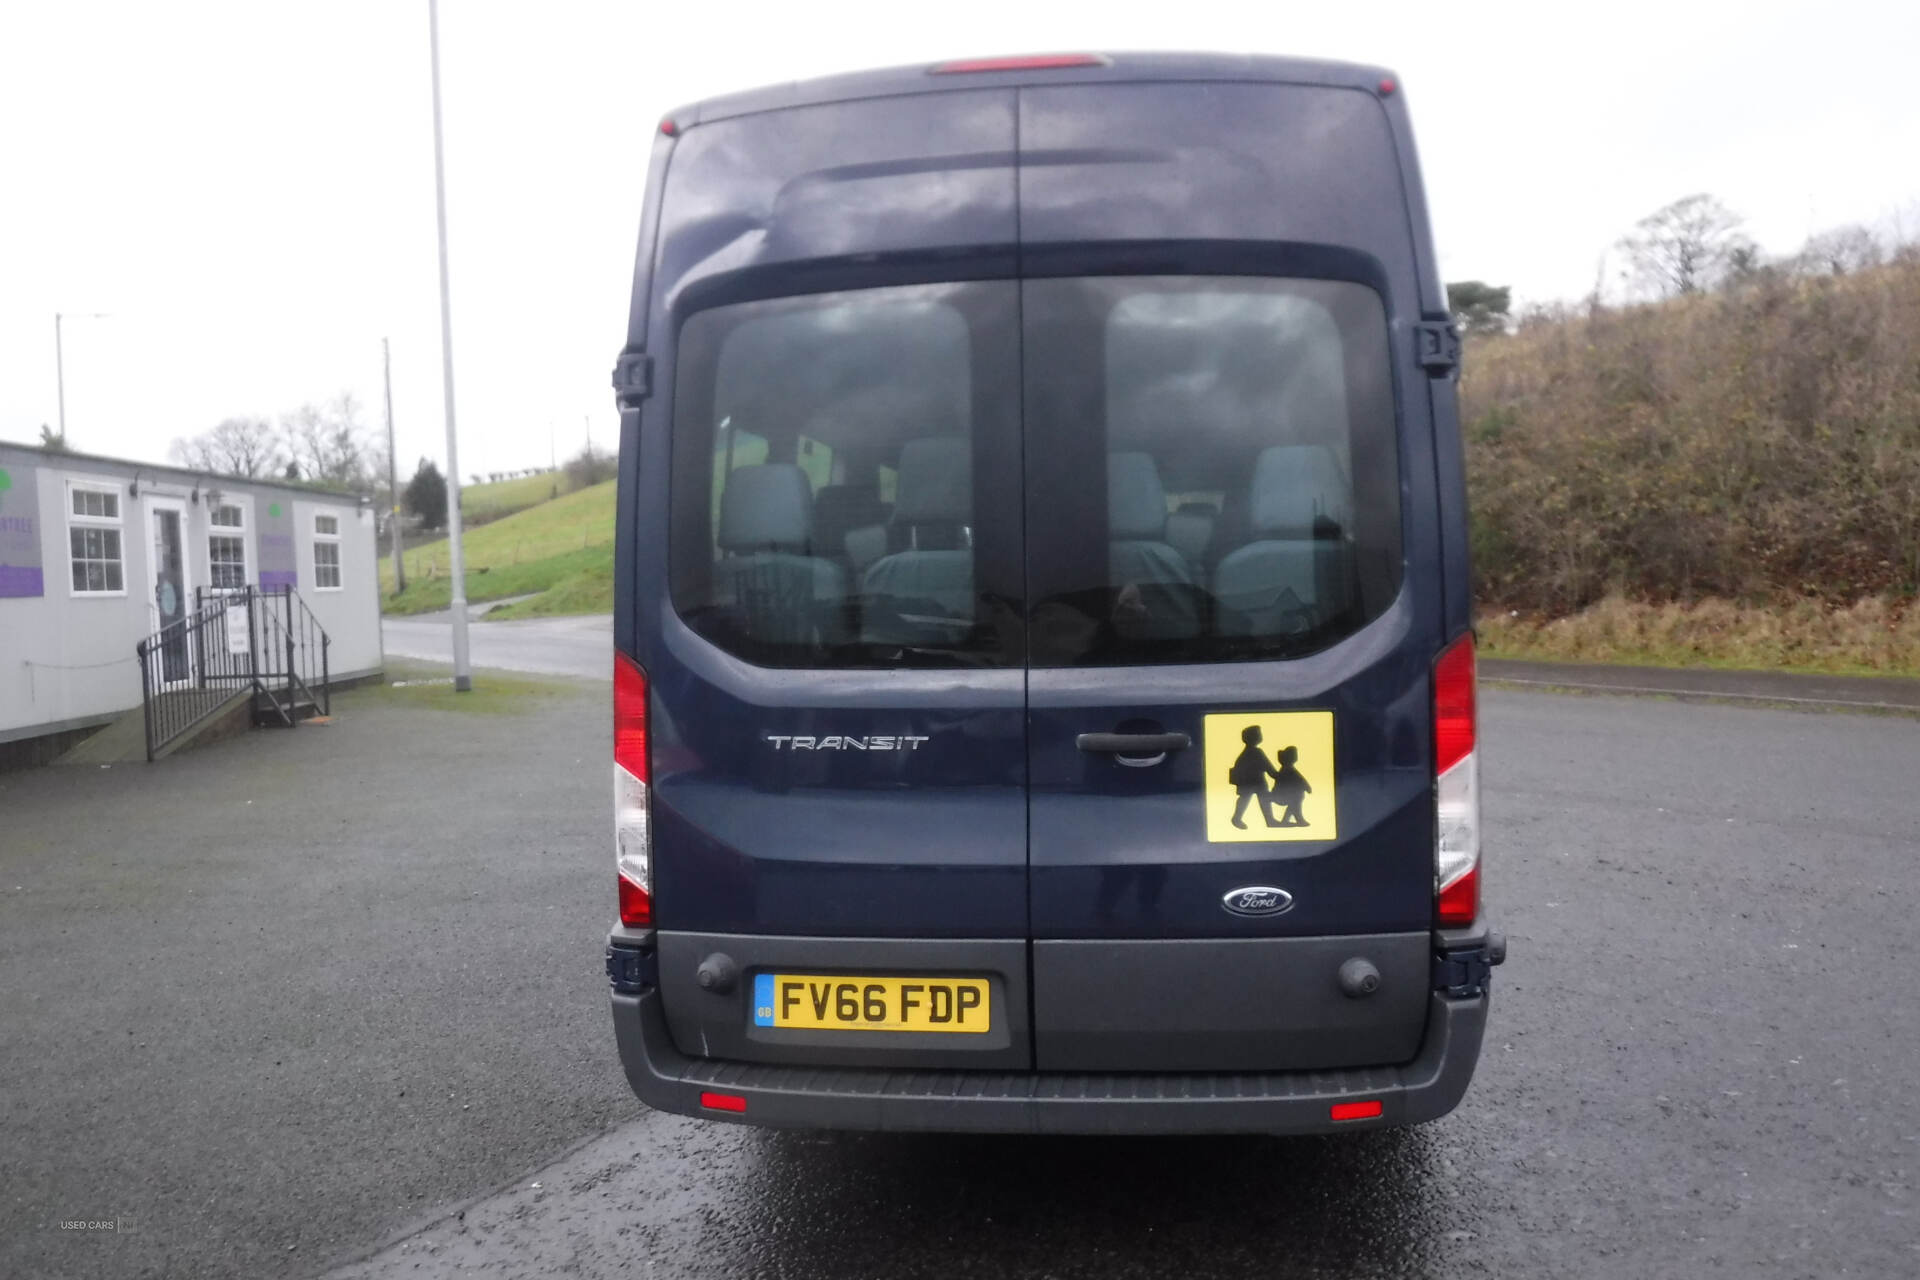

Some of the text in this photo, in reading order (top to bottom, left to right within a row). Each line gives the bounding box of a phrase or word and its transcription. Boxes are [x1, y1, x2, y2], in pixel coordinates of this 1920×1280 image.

[767, 735, 930, 750] TRANSIT
[1239, 892, 1277, 908] Ford
[782, 982, 981, 1024] FV66 FDP
[758, 1007, 772, 1017] GB
